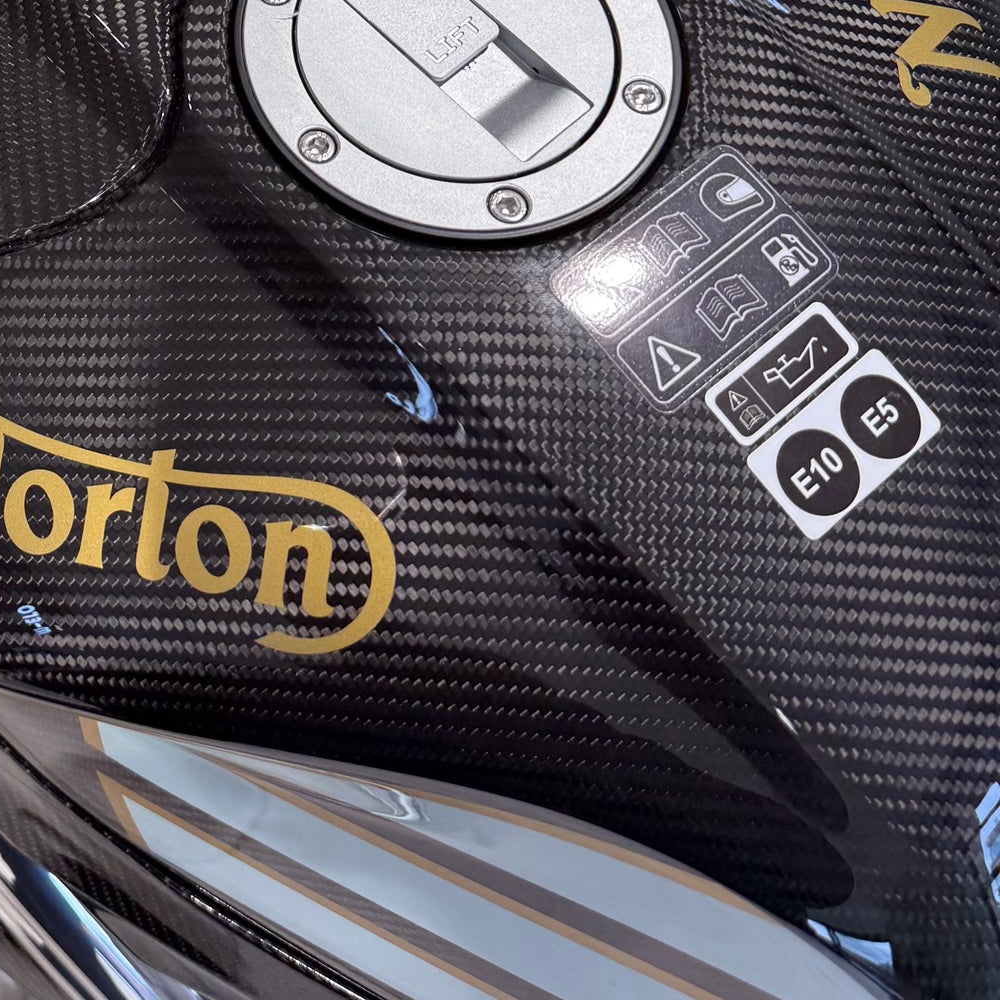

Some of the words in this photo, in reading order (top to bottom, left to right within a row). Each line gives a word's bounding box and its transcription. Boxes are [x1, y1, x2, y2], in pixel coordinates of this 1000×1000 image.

[425, 16, 479, 64] LIFT
[790, 447, 843, 499] E10
[859, 396, 899, 438] E5
